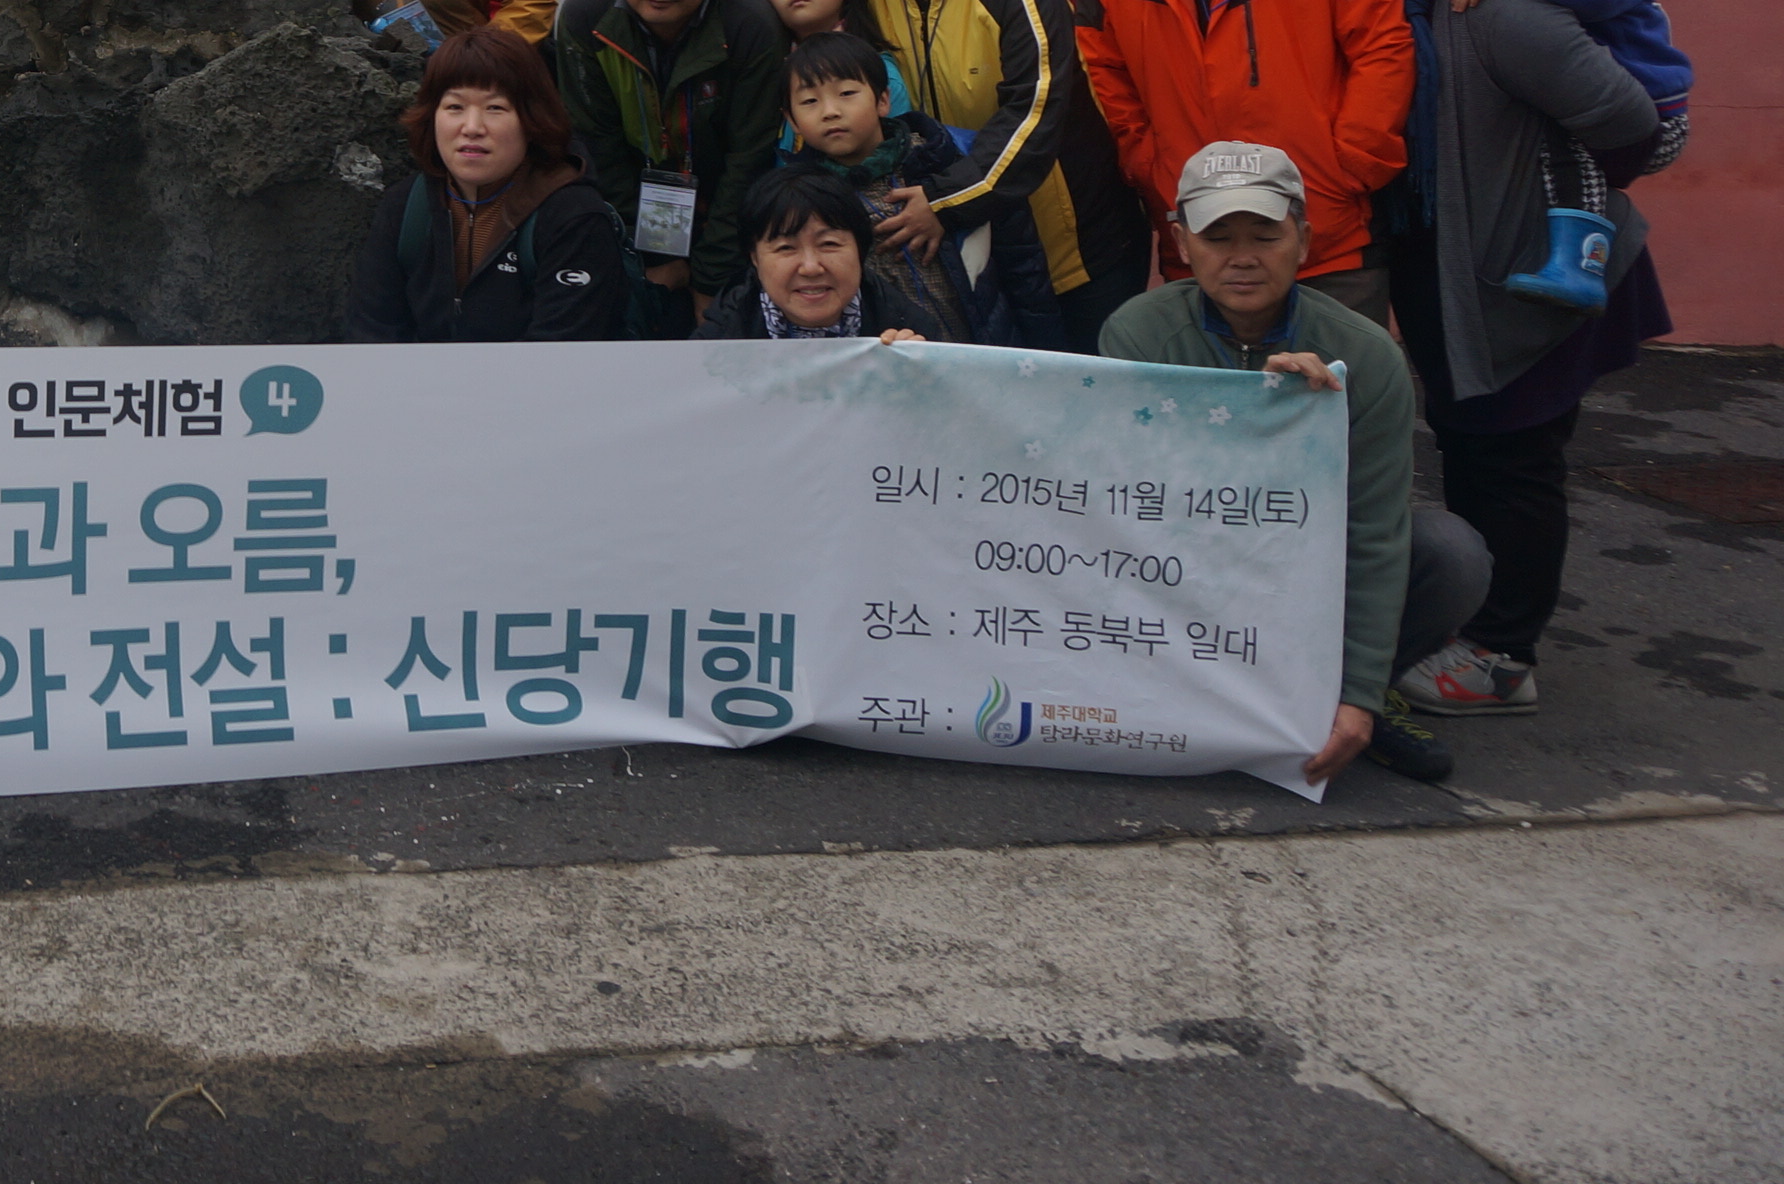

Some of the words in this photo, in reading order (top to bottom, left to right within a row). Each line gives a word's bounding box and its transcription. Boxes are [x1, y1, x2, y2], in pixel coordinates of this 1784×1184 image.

[1201, 154, 1262, 180] EVERLAST
[8, 379, 222, 438] 인문체험
[267, 380, 297, 418] 4
[872, 466, 939, 505] 일시
[981, 472, 1089, 516] 2015년
[1106, 482, 1166, 522] 11월
[1184, 486, 1309, 530] 14일(토)
[127, 478, 356, 596] 오름,
[974, 540, 1183, 587] 09:00~17:00
[862, 600, 932, 640] 장소
[972, 606, 1044, 647] 제주
[1060, 612, 1170, 657] 동북부
[1186, 622, 1257, 666] 일대
[89, 616, 295, 750] 전설
[384, 608, 796, 730] 신당기행
[858, 697, 930, 735] 주관
[1041, 704, 1118, 724] 제주대학교
[1040, 724, 1188, 753] 탐라문화연구원
